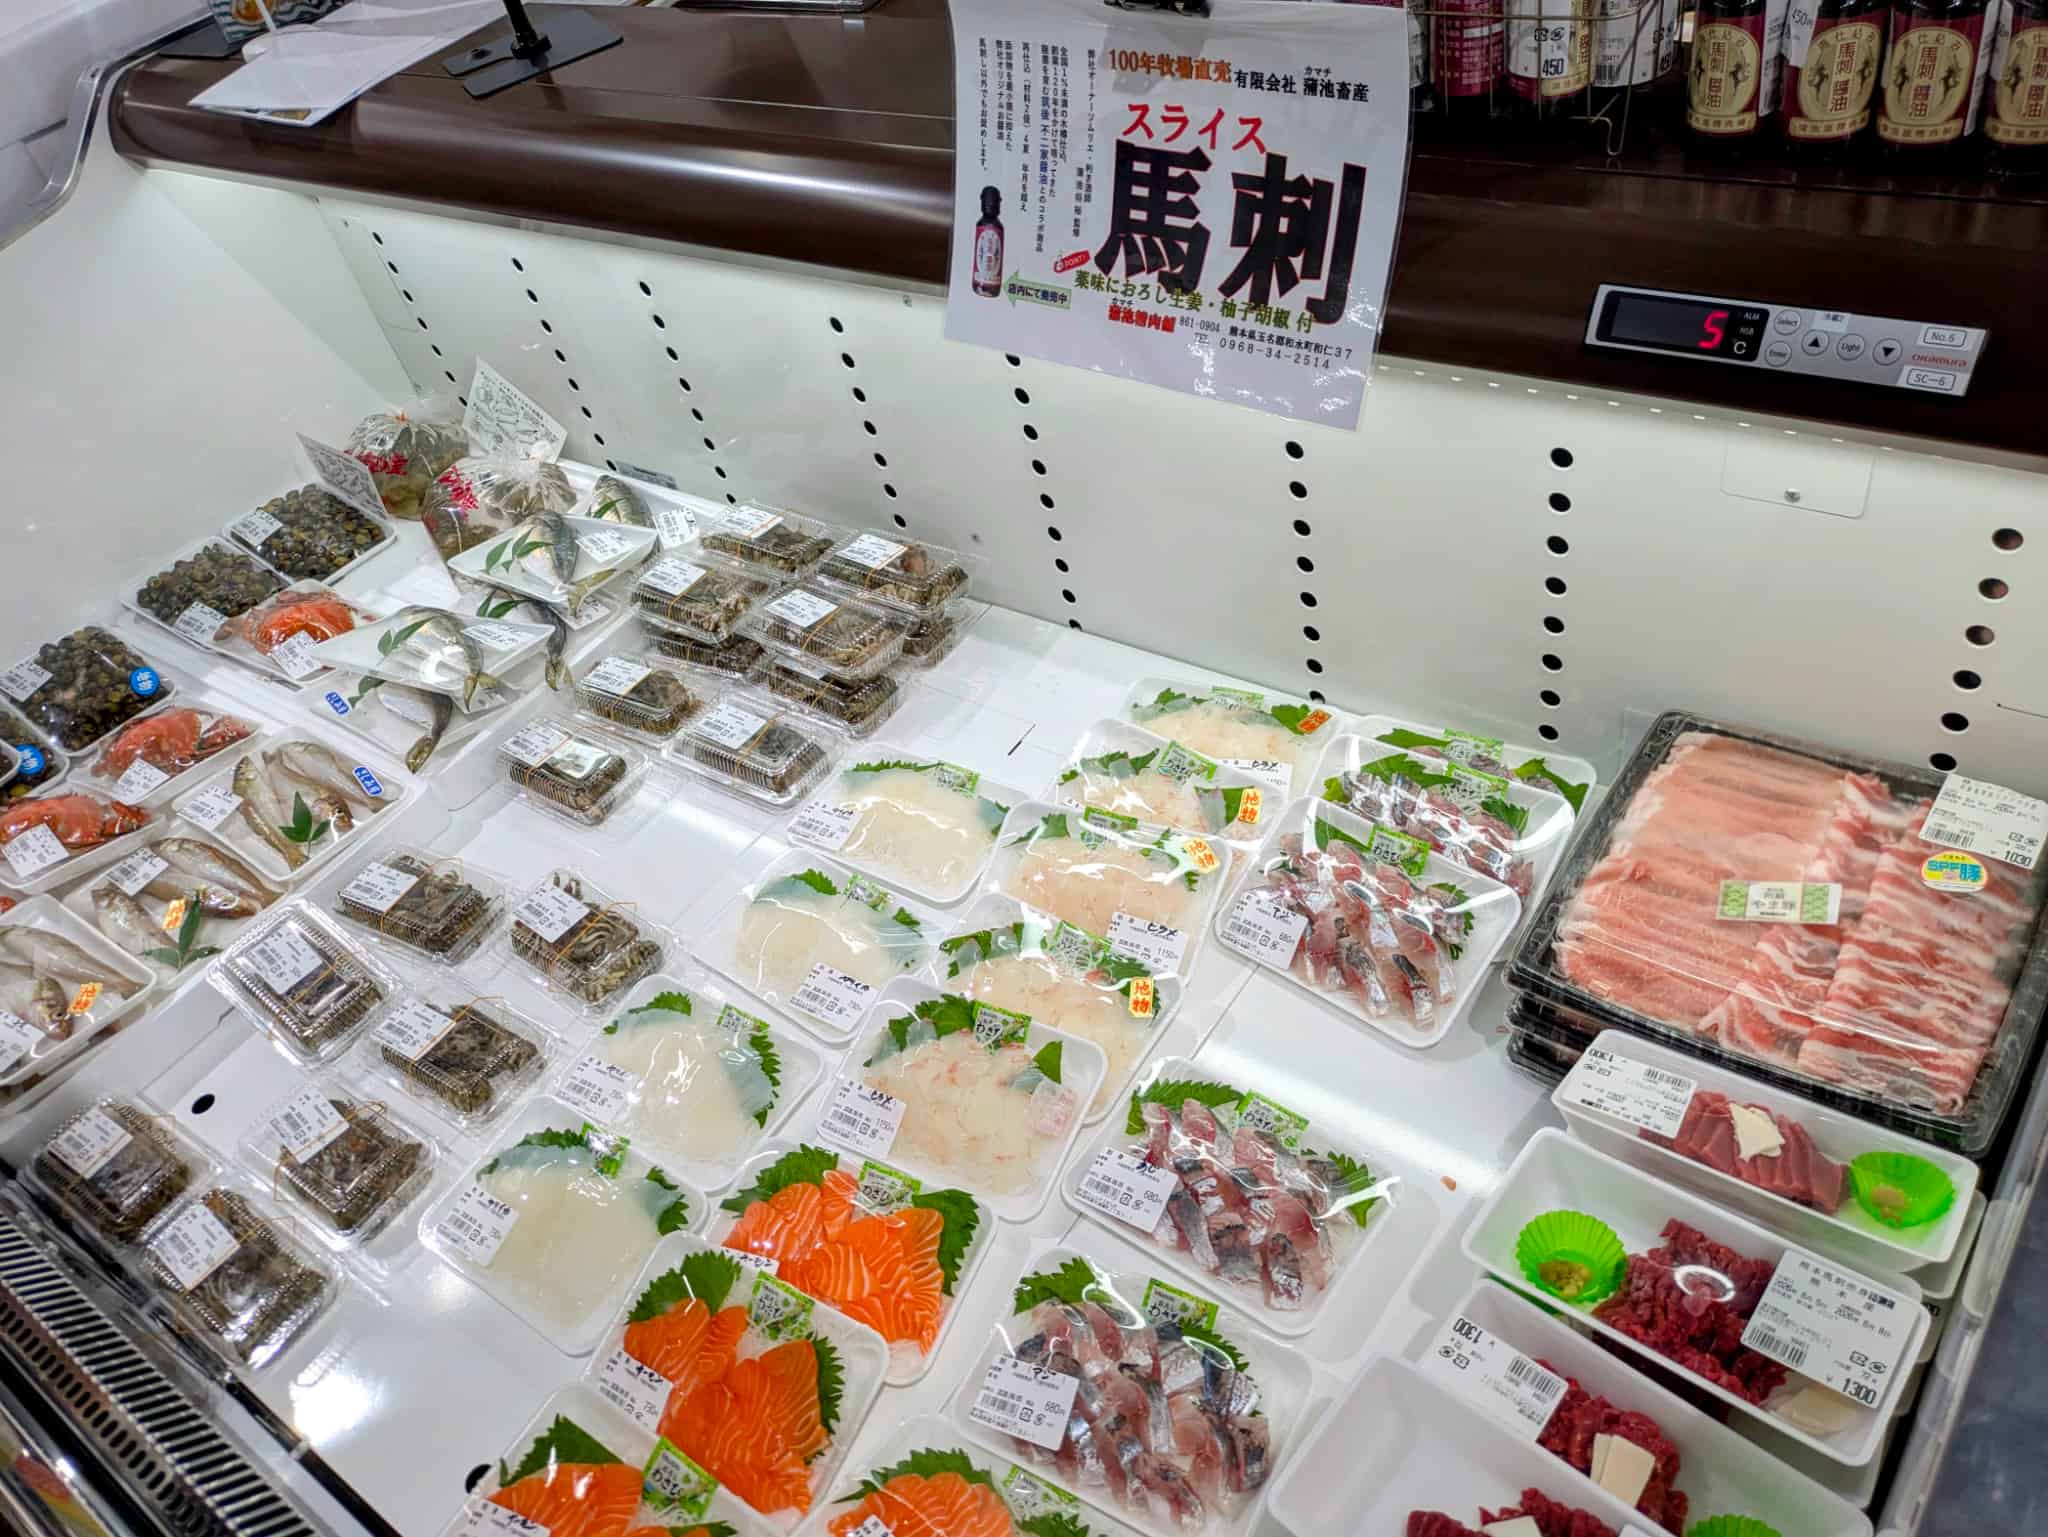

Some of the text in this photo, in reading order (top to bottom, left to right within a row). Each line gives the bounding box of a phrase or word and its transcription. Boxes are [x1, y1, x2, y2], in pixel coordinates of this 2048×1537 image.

[1107, 49, 1232, 84] 100年牧場直売
[1234, 69, 1297, 94] 有限会社
[1543, 58, 1564, 76] 450
[1122, 103, 1266, 154] スライス
[1094, 139, 1367, 325] 馬刺
[1074, 269, 1315, 334] 薬味におろし生姜・柚子胡椒 付
[1698, 310, 1729, 349] 5
[1930, 331, 1956, 343] No.6
[1219, 337, 1332, 370] 0968-34-2514
[1452, 1317, 1483, 1344] 1300
[1841, 1377, 1878, 1405] 1300
